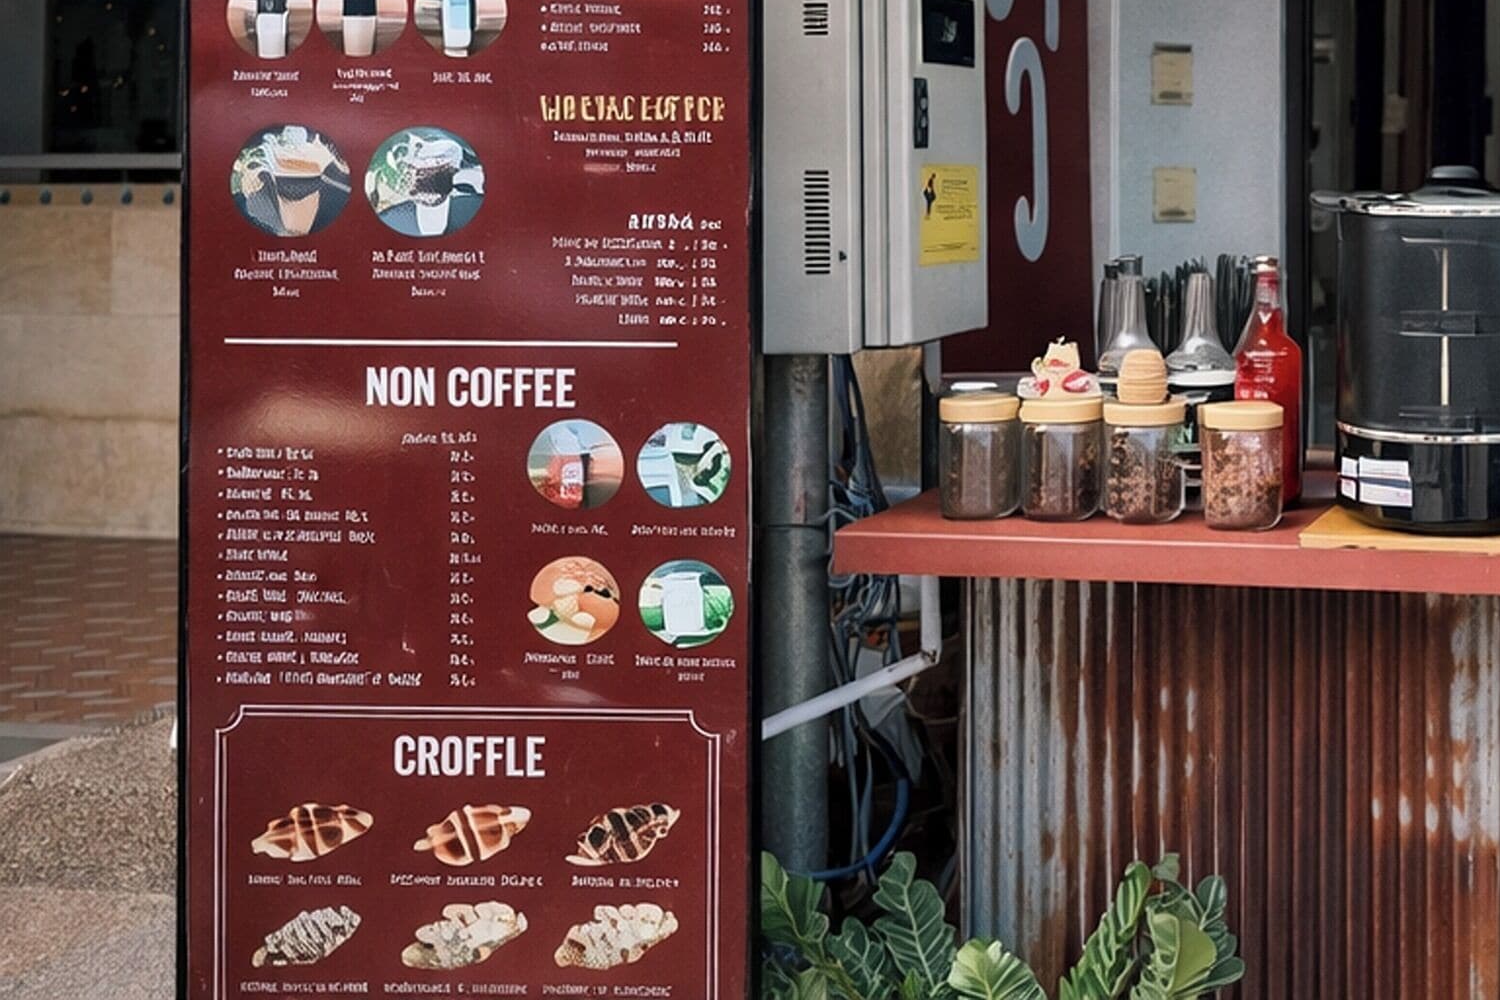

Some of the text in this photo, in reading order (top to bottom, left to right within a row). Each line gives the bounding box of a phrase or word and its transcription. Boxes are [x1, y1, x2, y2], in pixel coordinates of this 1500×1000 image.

[366, 366, 576, 408] NON COFFEE
[394, 735, 546, 777] CROFFLE
